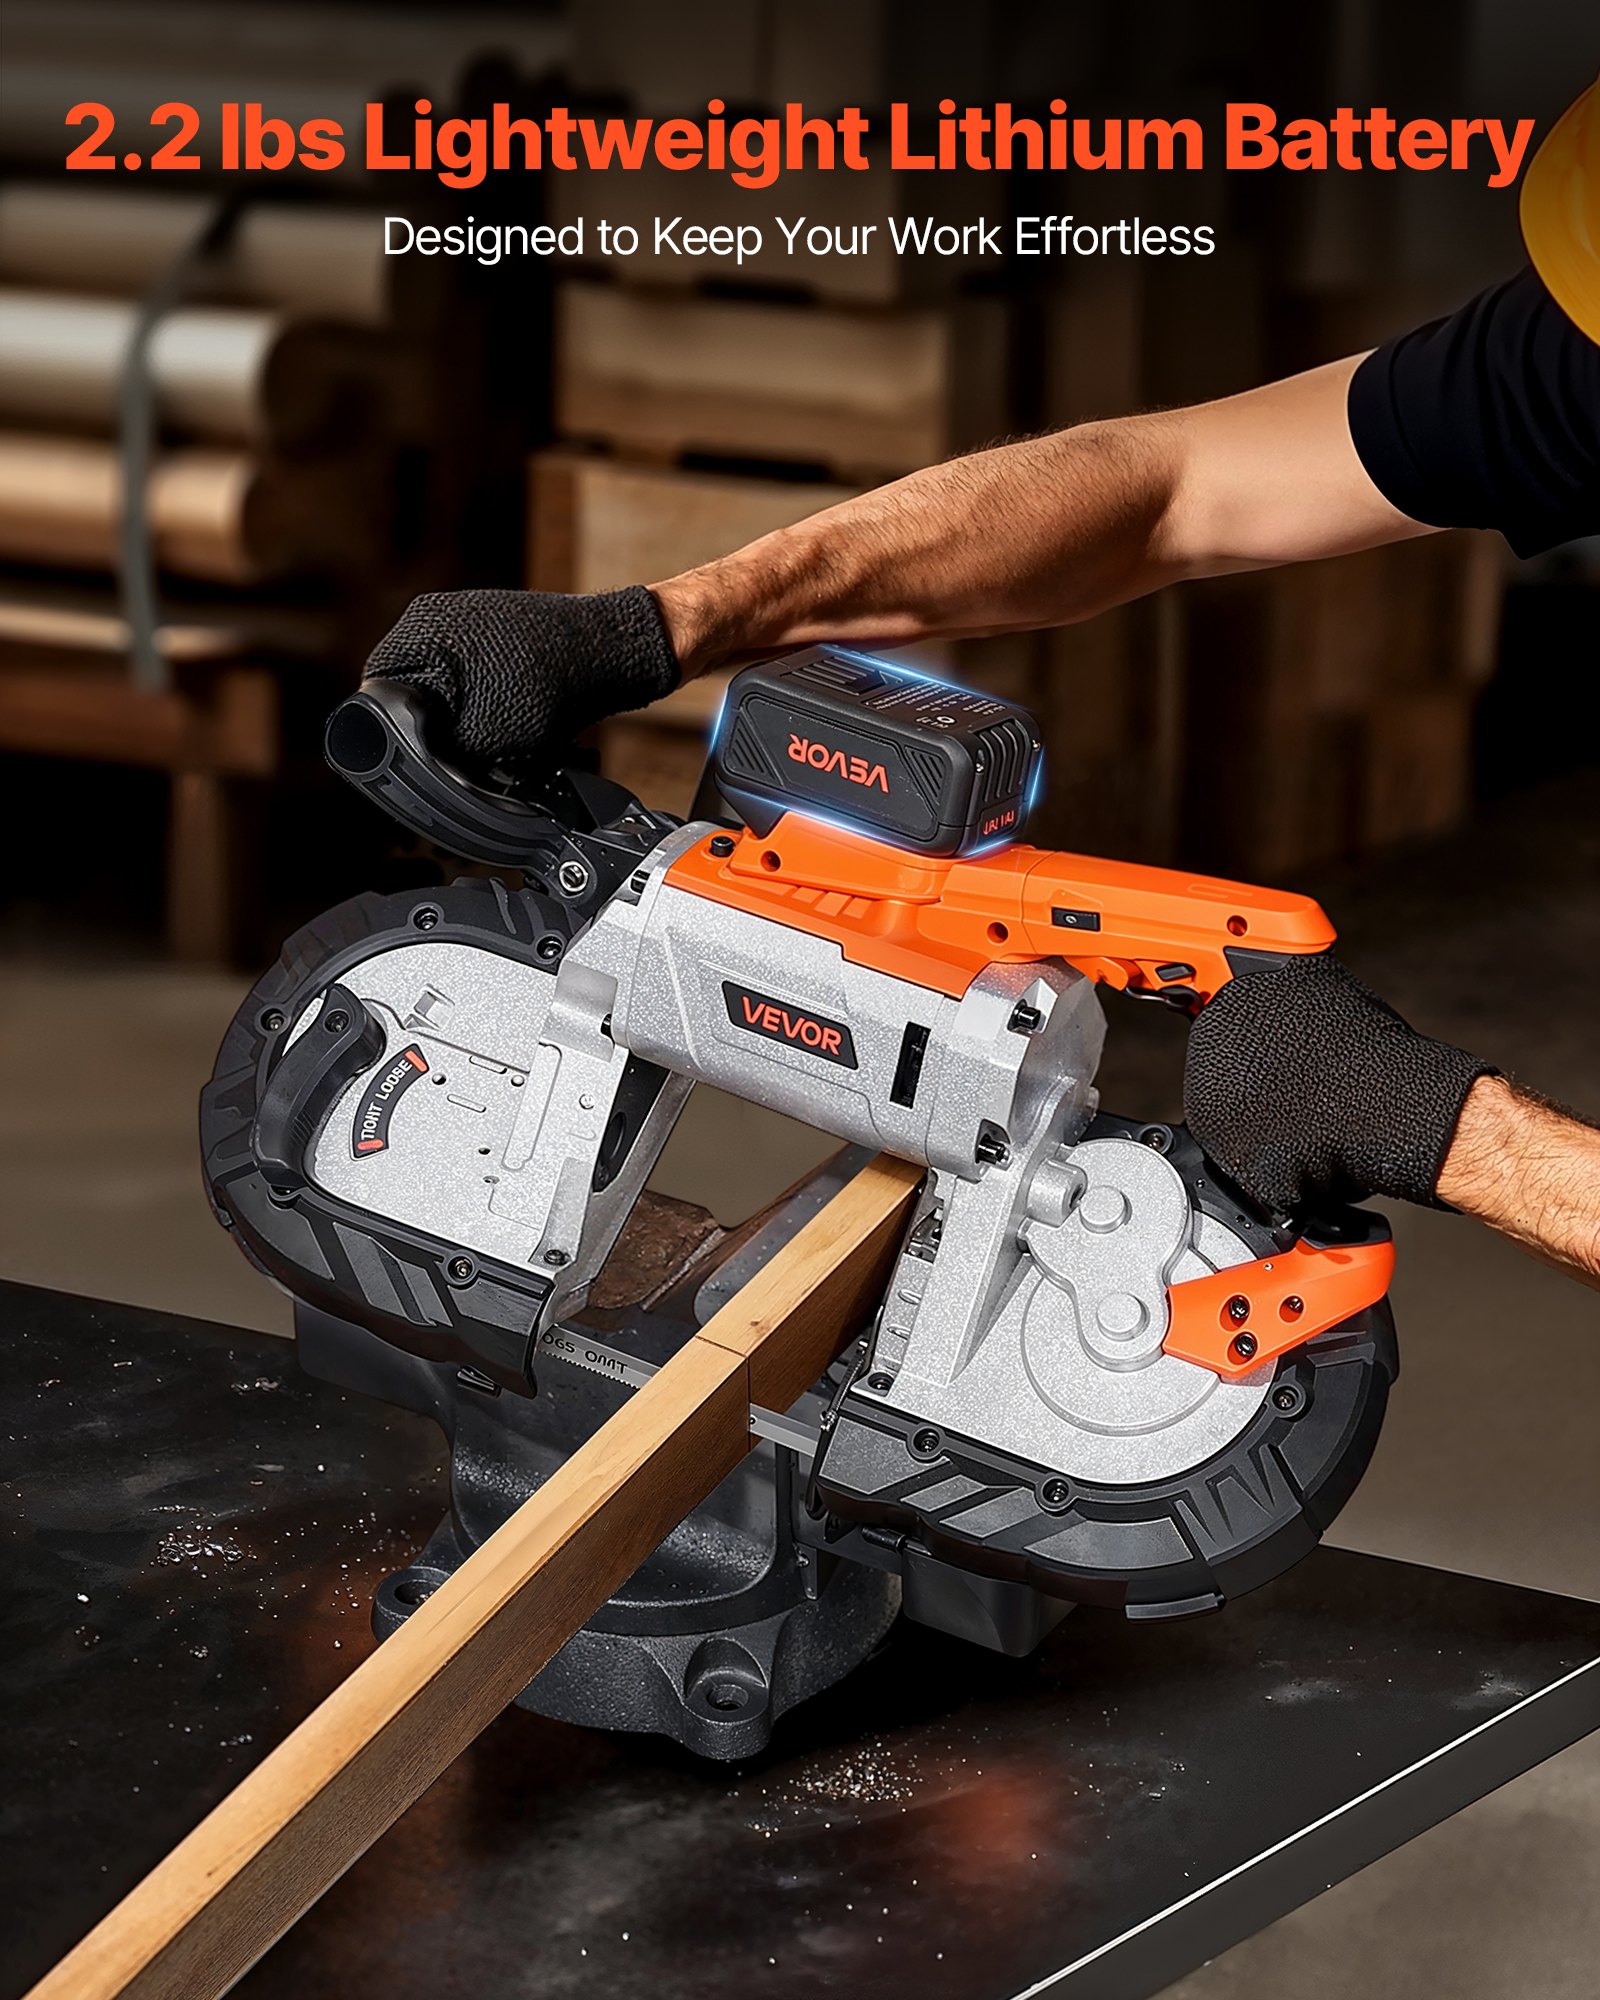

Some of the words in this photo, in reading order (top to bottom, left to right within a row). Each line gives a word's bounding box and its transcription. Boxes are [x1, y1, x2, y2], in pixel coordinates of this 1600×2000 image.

[787, 733, 889, 794] VEVOR
[741, 995, 842, 1056] VEVOR
[375, 1059, 413, 1101] LOOSE
